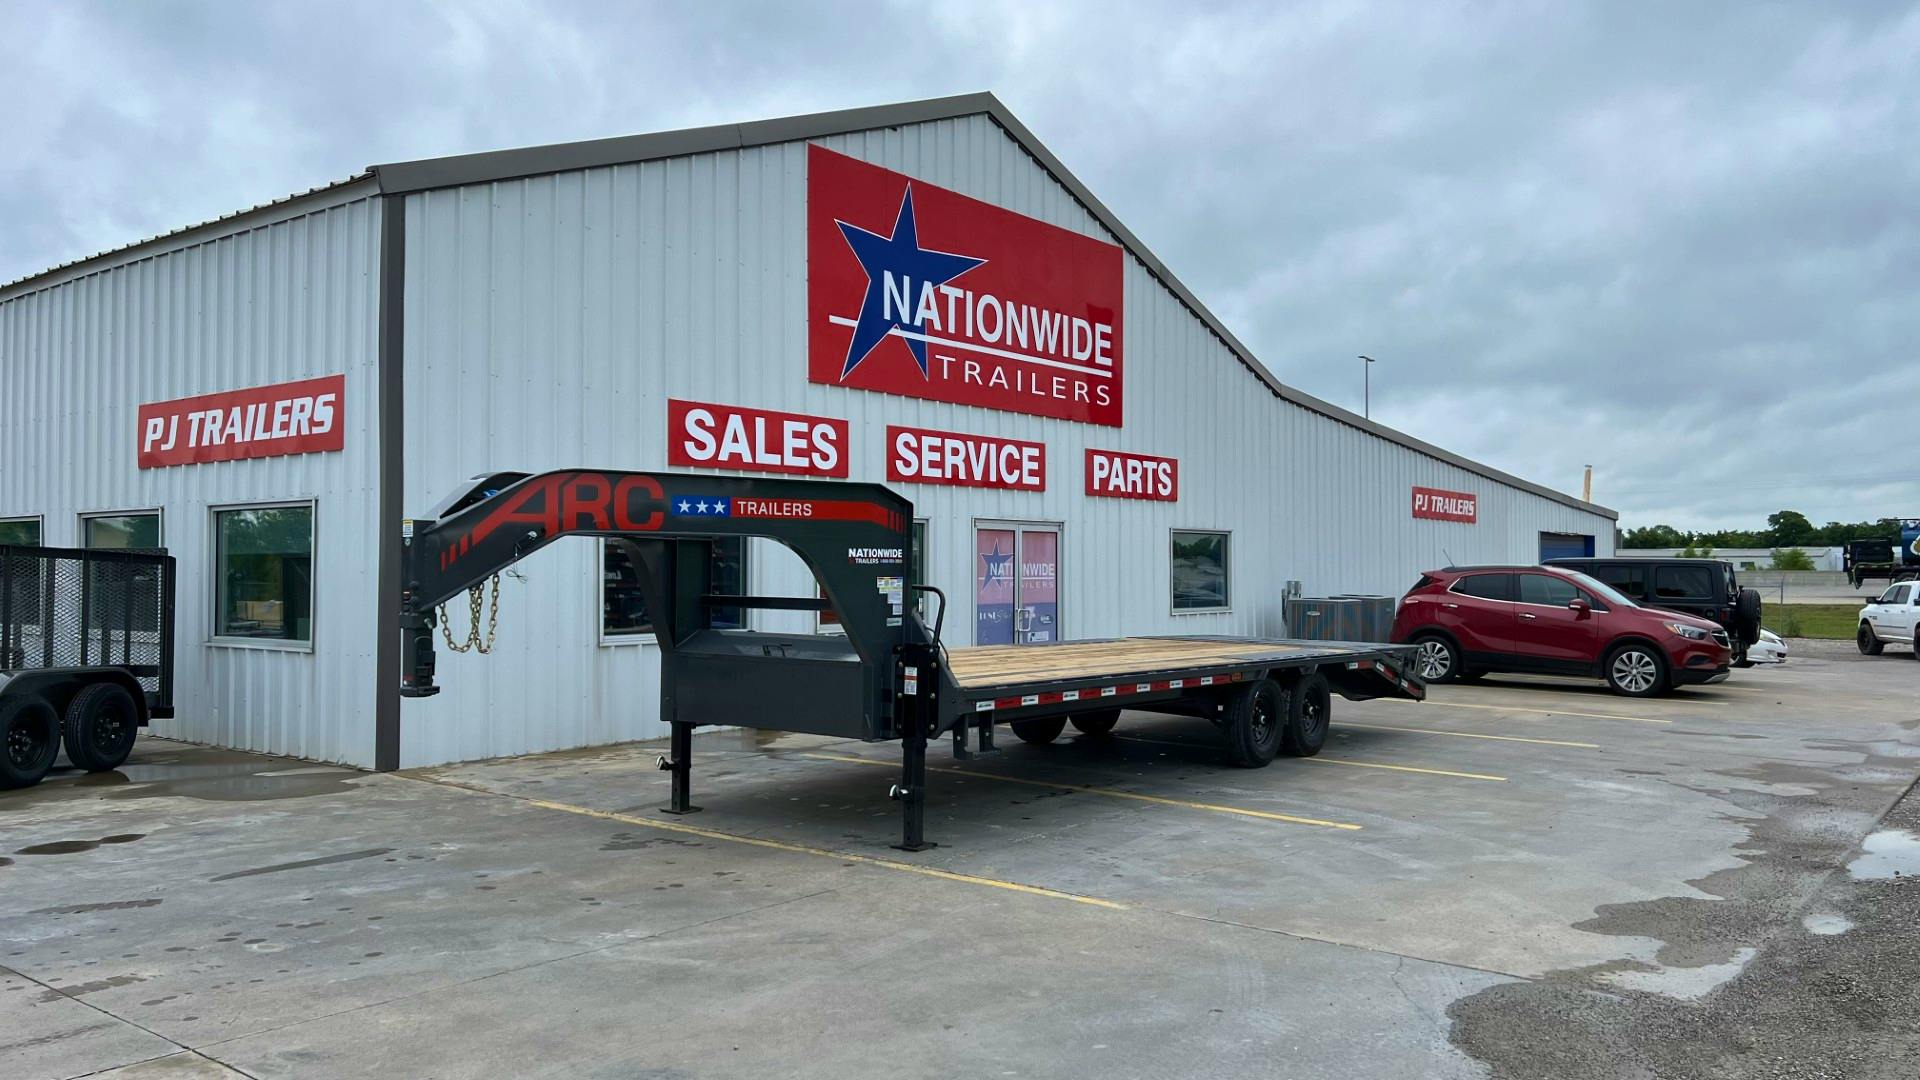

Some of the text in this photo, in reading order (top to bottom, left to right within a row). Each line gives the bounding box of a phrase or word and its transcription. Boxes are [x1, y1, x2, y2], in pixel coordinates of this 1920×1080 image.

[883, 270, 1113, 366] NATIONWIDE
[935, 355, 1111, 406] TRAILERS
[143, 393, 336, 453] PJ TRAILERS
[684, 409, 838, 470] SALES
[895, 432, 1040, 485] SERVICE
[1093, 454, 1172, 496] PARTS
[471, 473, 812, 538] ARC TRAILERS
[1415, 494, 1475, 516] PJ TRAILERS
[848, 548, 902, 558] NATIONWIDE
